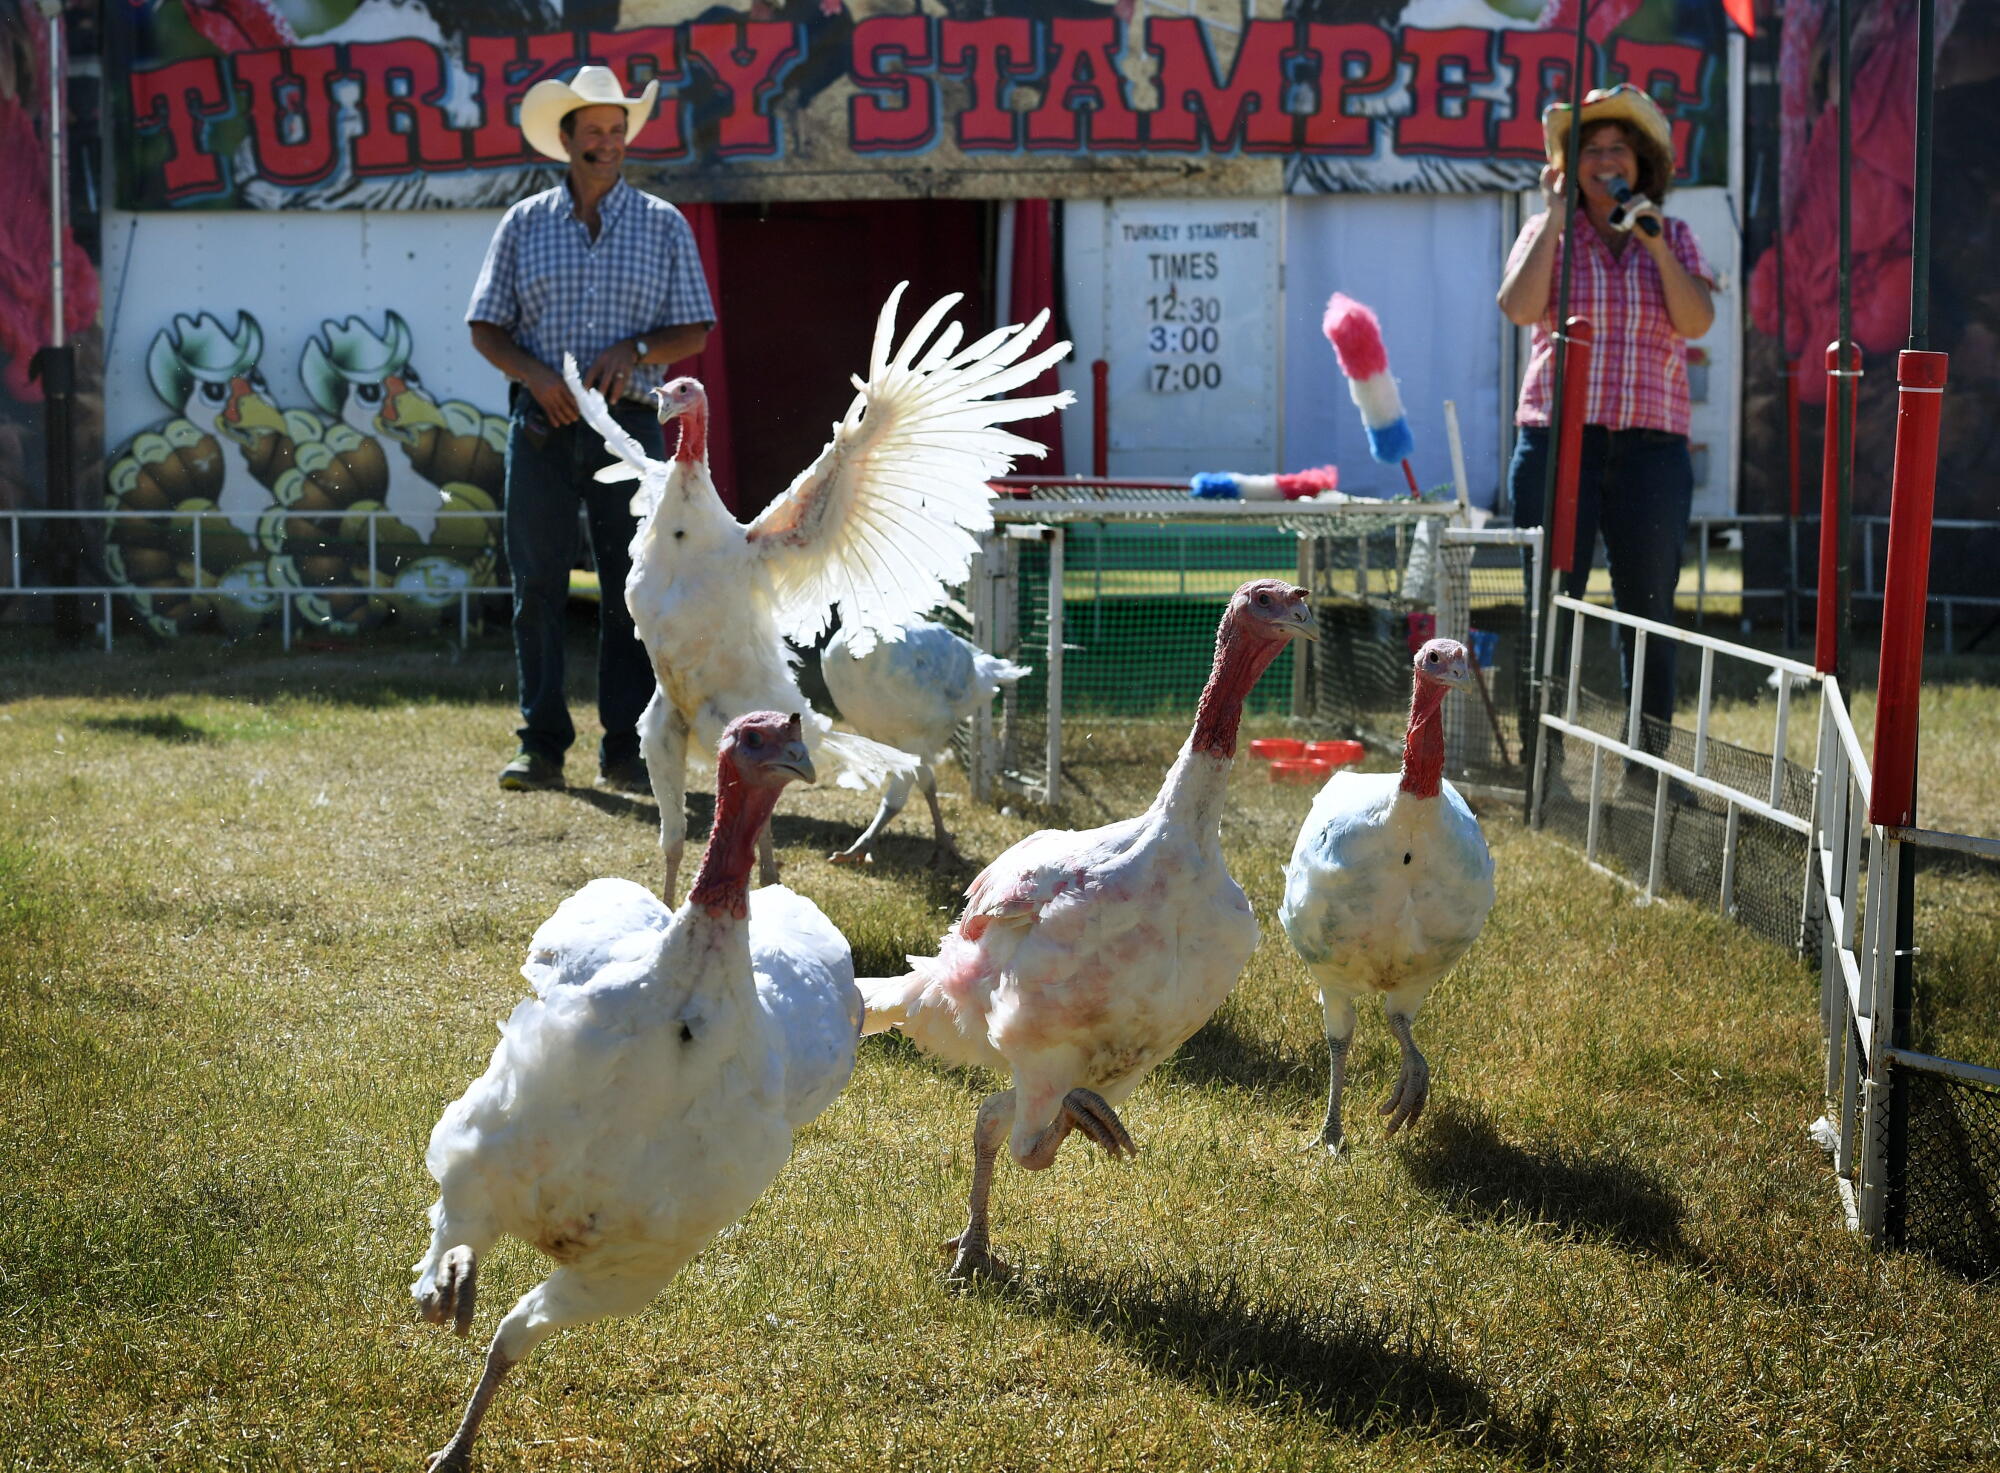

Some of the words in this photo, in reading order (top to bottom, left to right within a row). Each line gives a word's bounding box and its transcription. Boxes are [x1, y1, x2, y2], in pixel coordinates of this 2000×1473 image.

[129, 21, 801, 198] TURKEY
[1123, 224, 1179, 241] TURKEY
[1187, 221, 1259, 241] STAMPEDE
[1149, 252, 1219, 281] TIMES
[1147, 296, 1221, 323] 12:30
[1150, 326, 1219, 353] 3:00
[1153, 362, 1222, 391] 7:00
